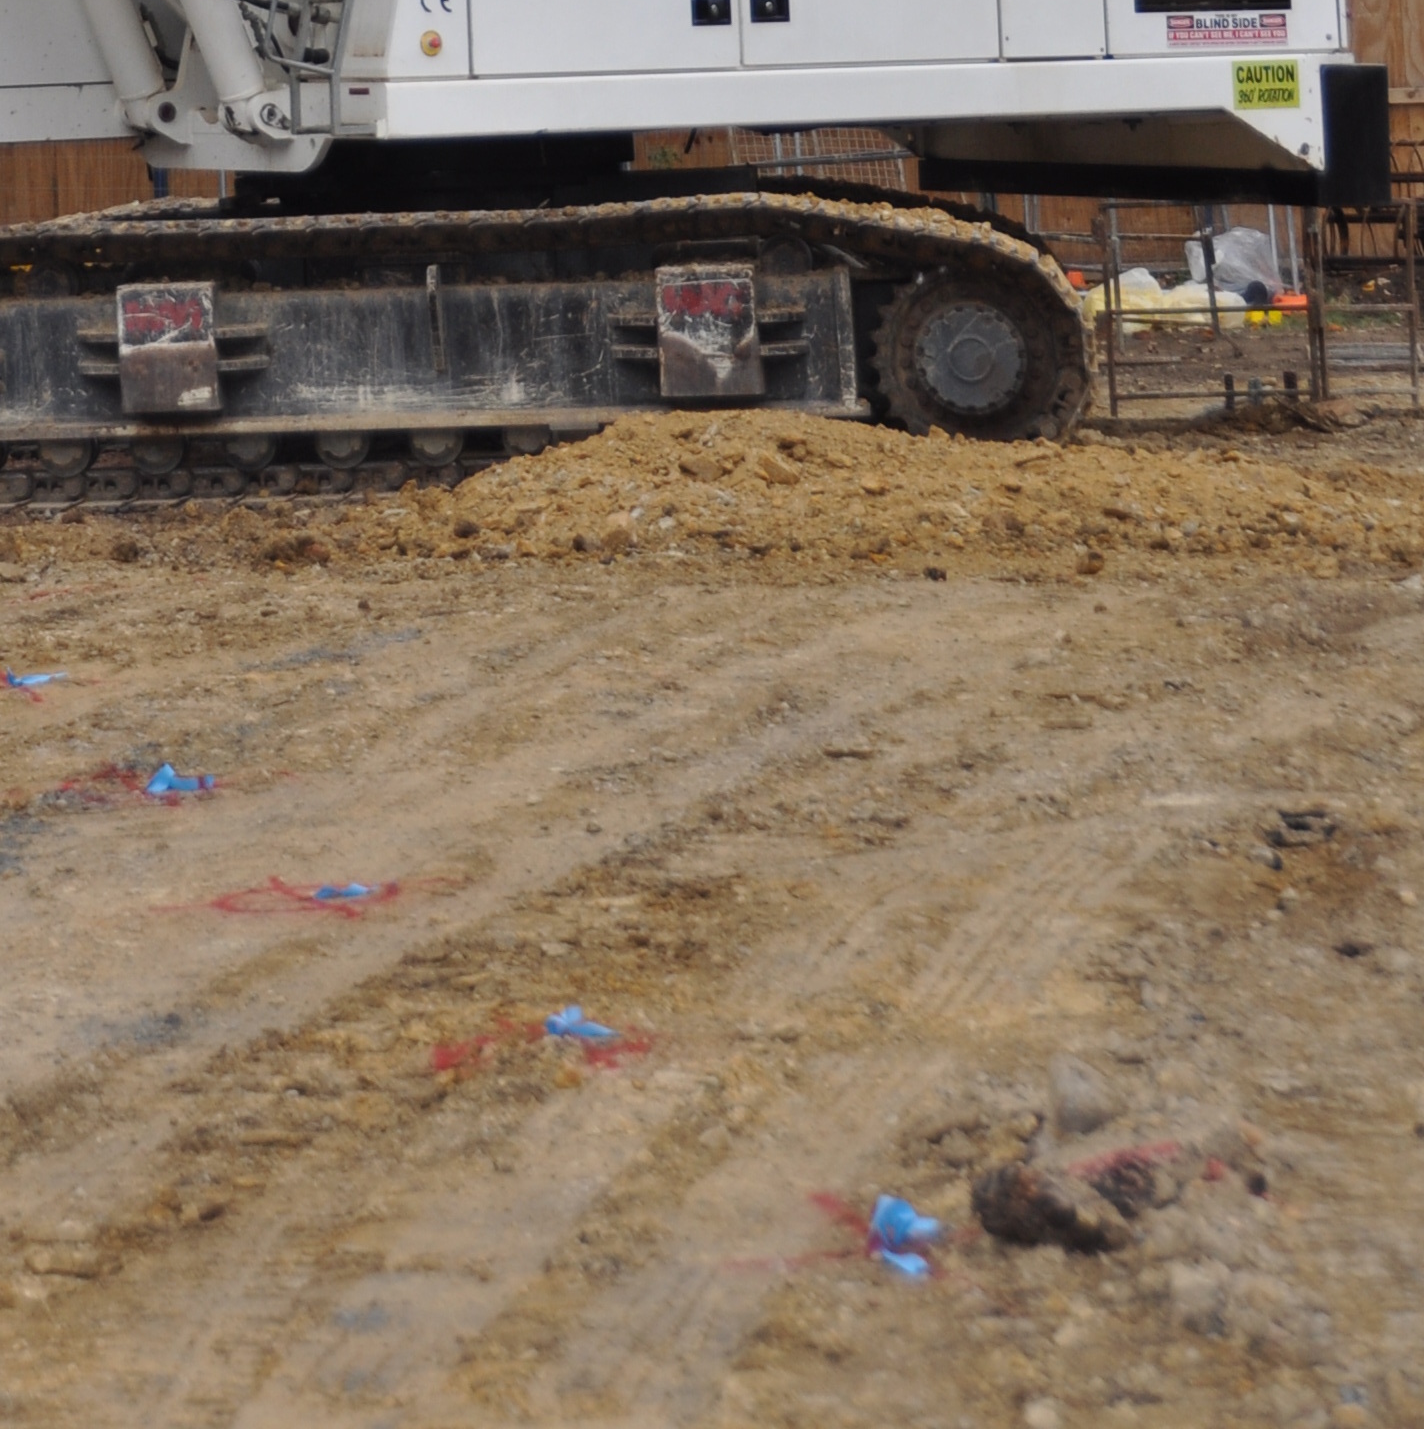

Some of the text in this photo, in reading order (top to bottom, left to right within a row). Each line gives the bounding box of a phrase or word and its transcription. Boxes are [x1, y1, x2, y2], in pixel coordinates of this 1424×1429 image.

[1195, 17, 1258, 29] BLIND SIDE
[1175, 31, 1188, 39] YOU
[1189, 30, 1209, 39] CAN'T
[1210, 30, 1222, 38] SEE
[1239, 29, 1259, 38] CAN'T
[1260, 29, 1272, 37] SEE
[1272, 29, 1286, 37] YOU
[1236, 65, 1295, 84] CAUTION
[1258, 87, 1295, 103] ROTATION
